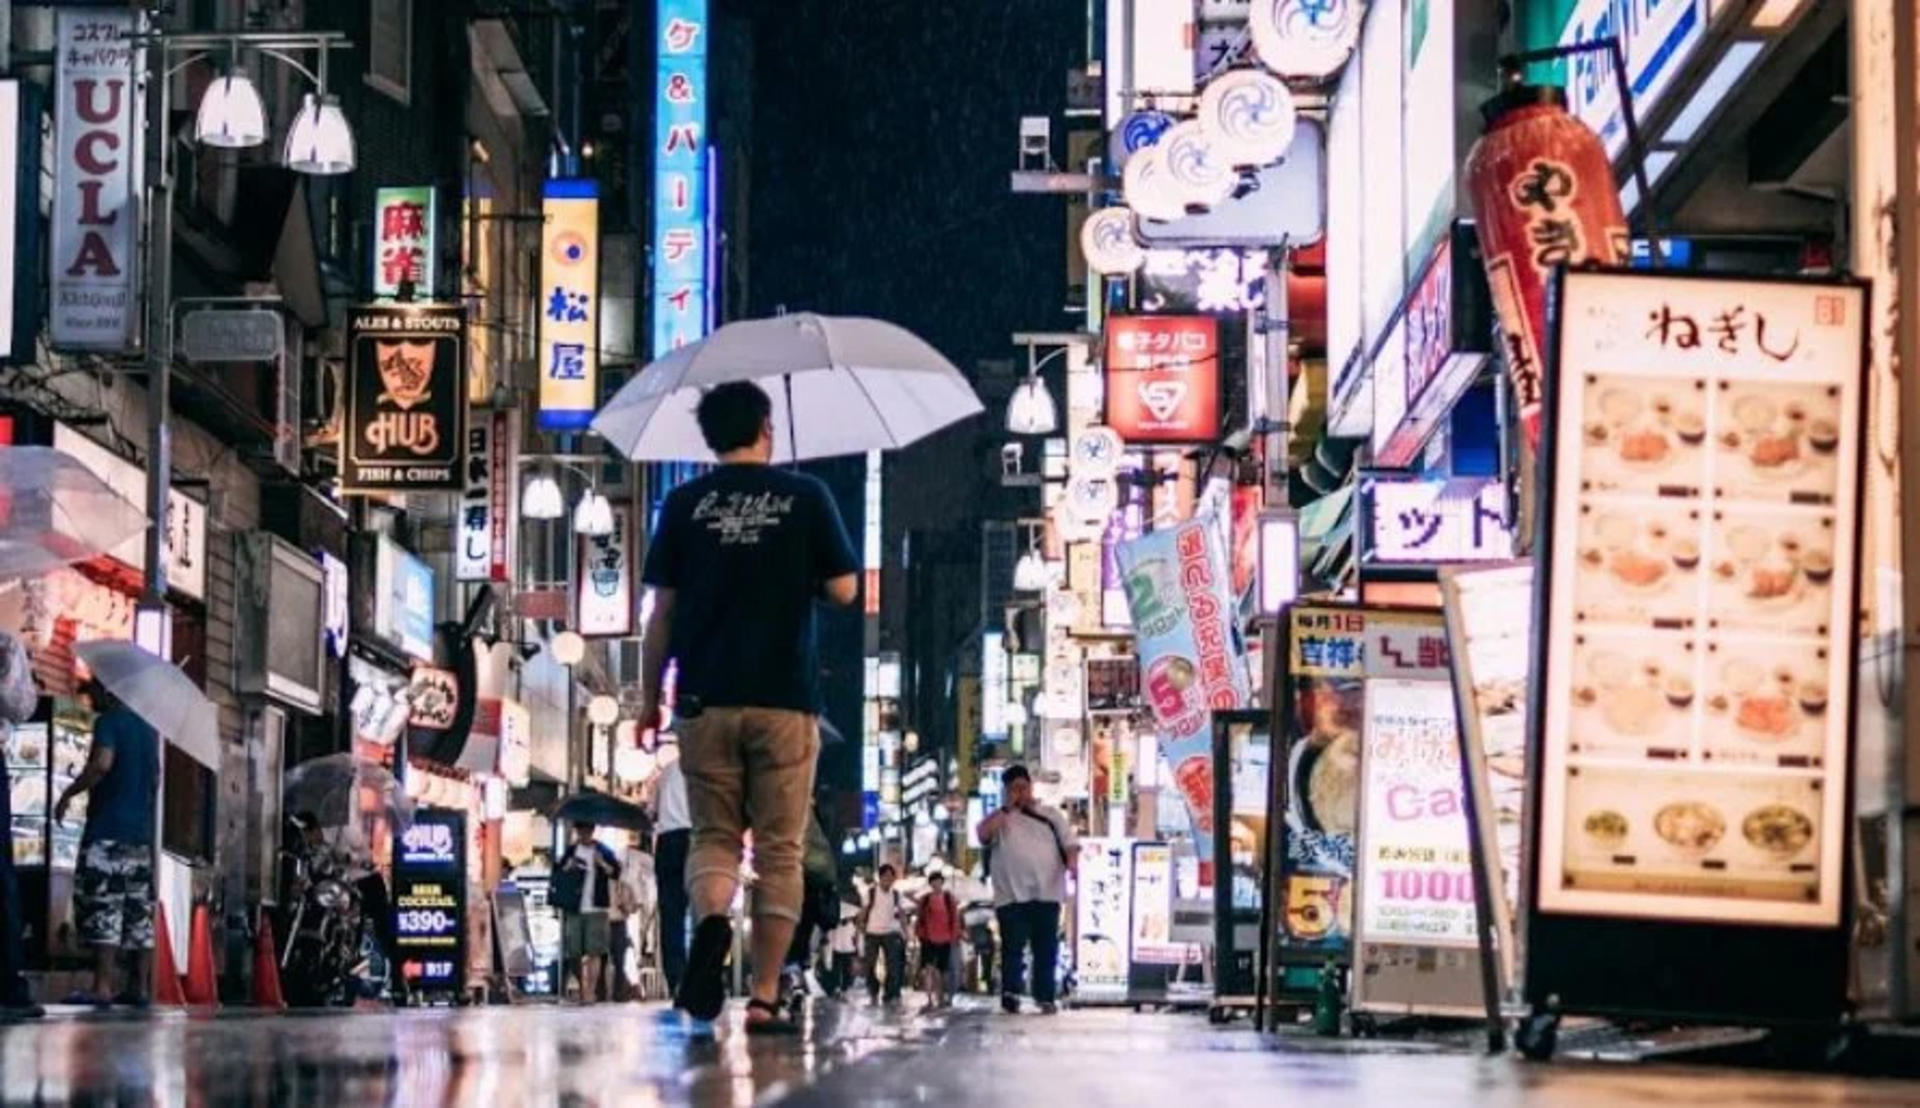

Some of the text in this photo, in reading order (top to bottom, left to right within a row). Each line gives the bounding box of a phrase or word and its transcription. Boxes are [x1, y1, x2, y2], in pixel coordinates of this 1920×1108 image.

[66, 79, 125, 277] UCLA
[382, 201, 427, 287] 麻雀
[354, 316, 389, 330] ALES
[404, 315, 461, 331] STOUTS
[547, 286, 590, 380] 松屋
[1646, 303, 1801, 362] ねぎし
[365, 412, 439, 455] HUB
[357, 467, 391, 481] FISH
[407, 467, 450, 481] CHIPS
[1398, 497, 1501, 548] ット
[1299, 634, 1364, 669] 吉祥
